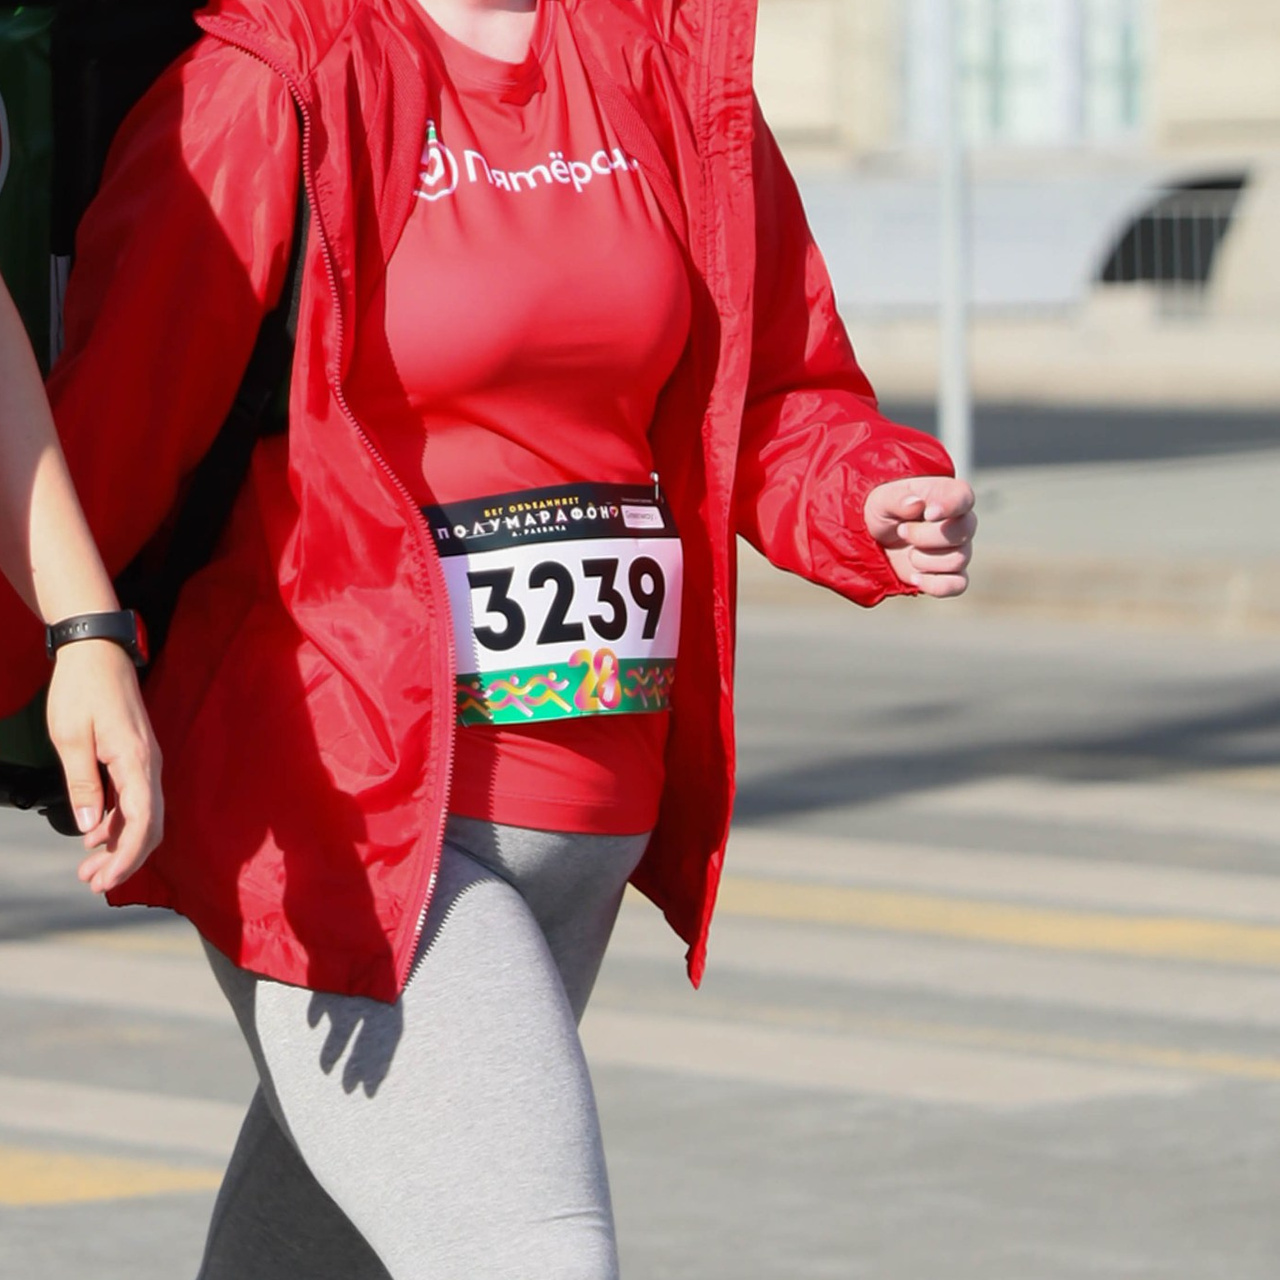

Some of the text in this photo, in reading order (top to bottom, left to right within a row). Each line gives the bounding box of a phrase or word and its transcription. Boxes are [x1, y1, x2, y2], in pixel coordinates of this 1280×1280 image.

[437, 505, 610, 540] ПОЛУМАРАФОН
[484, 497, 580, 518] БЕГ ОБЪЕДИНЯЕТ
[466, 556, 666, 652] 3239
